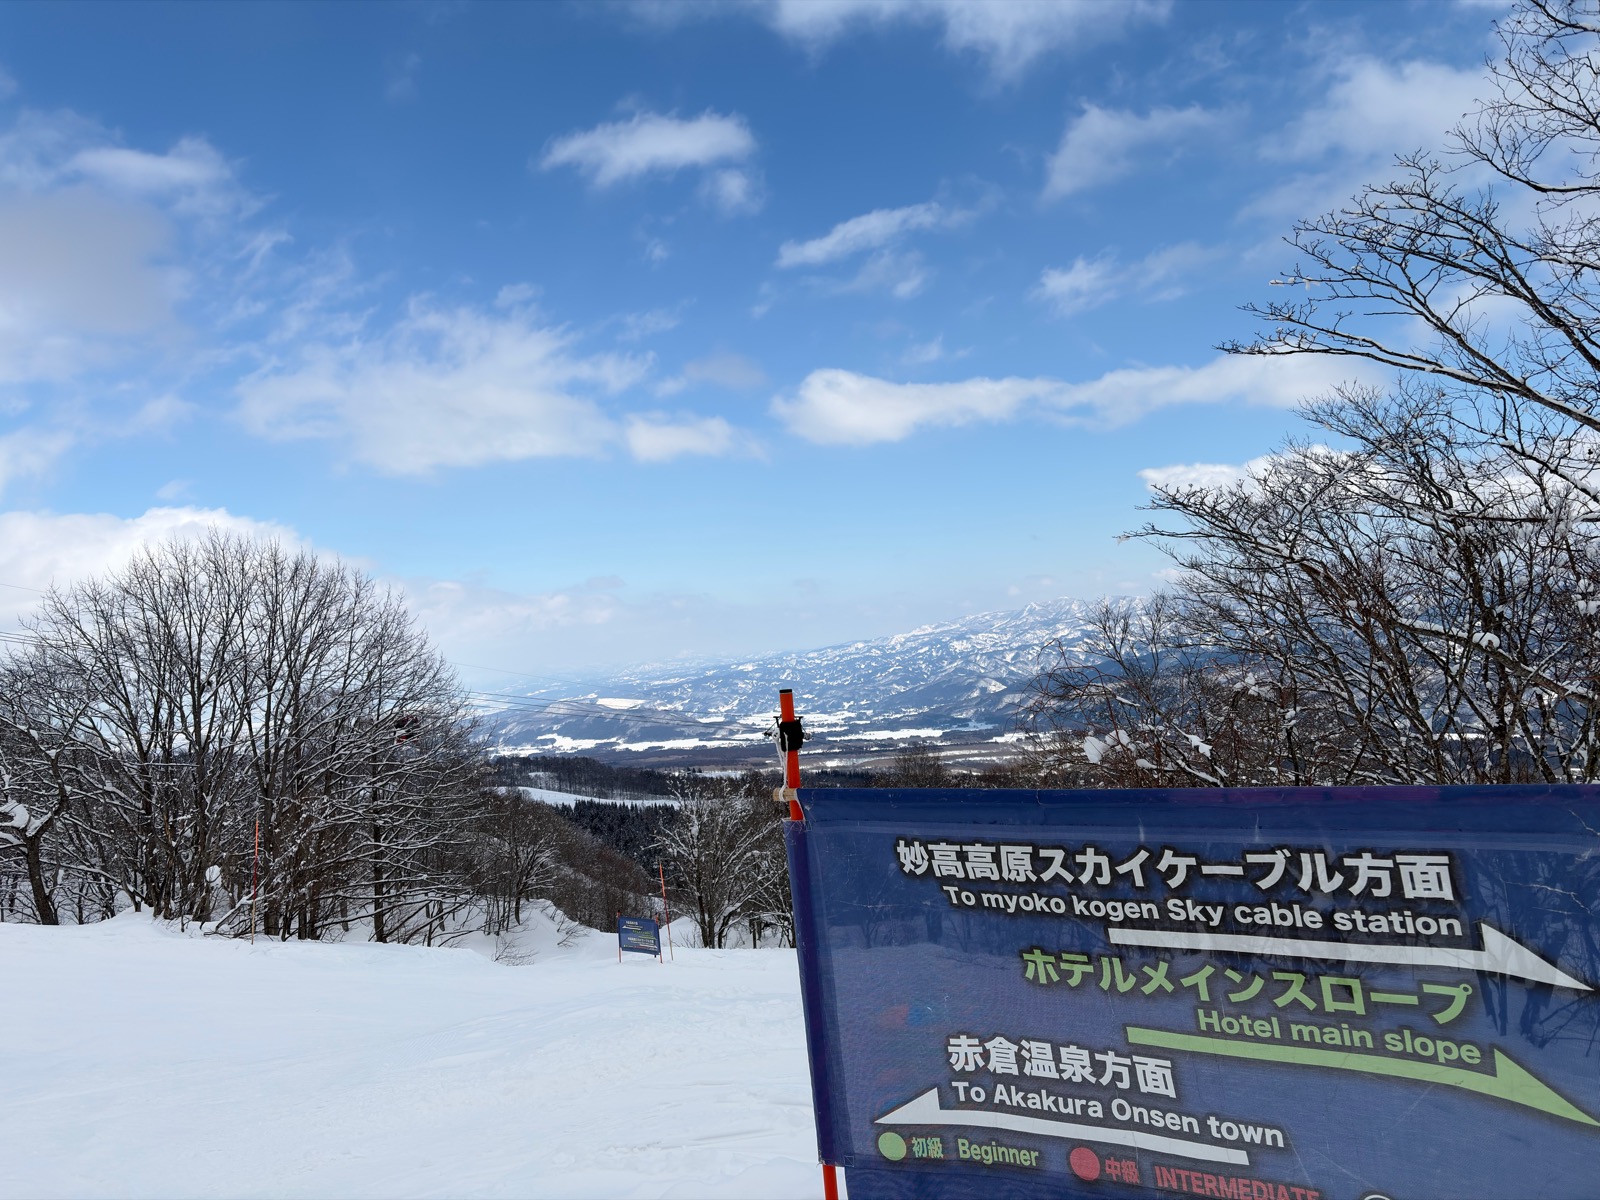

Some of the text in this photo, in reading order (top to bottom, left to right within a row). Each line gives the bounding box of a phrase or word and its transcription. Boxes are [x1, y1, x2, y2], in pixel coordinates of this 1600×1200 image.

[896, 840, 1454, 901] 妙高高原スカイケーブル方面
[943, 886, 1463, 936] To myoko kogen Sky cable station
[1022, 948, 1473, 1025] ホテルメインスロープ
[1198, 1009, 1481, 1065] Hotel main slope
[948, 1034, 1177, 1099] 赤倉温泉方面
[952, 1081, 1285, 1148] To Akakura Onsen town
[911, 1136, 944, 1160] 初級
[957, 1138, 1039, 1167] Beginner
[1104, 1157, 1140, 1184] 中級
